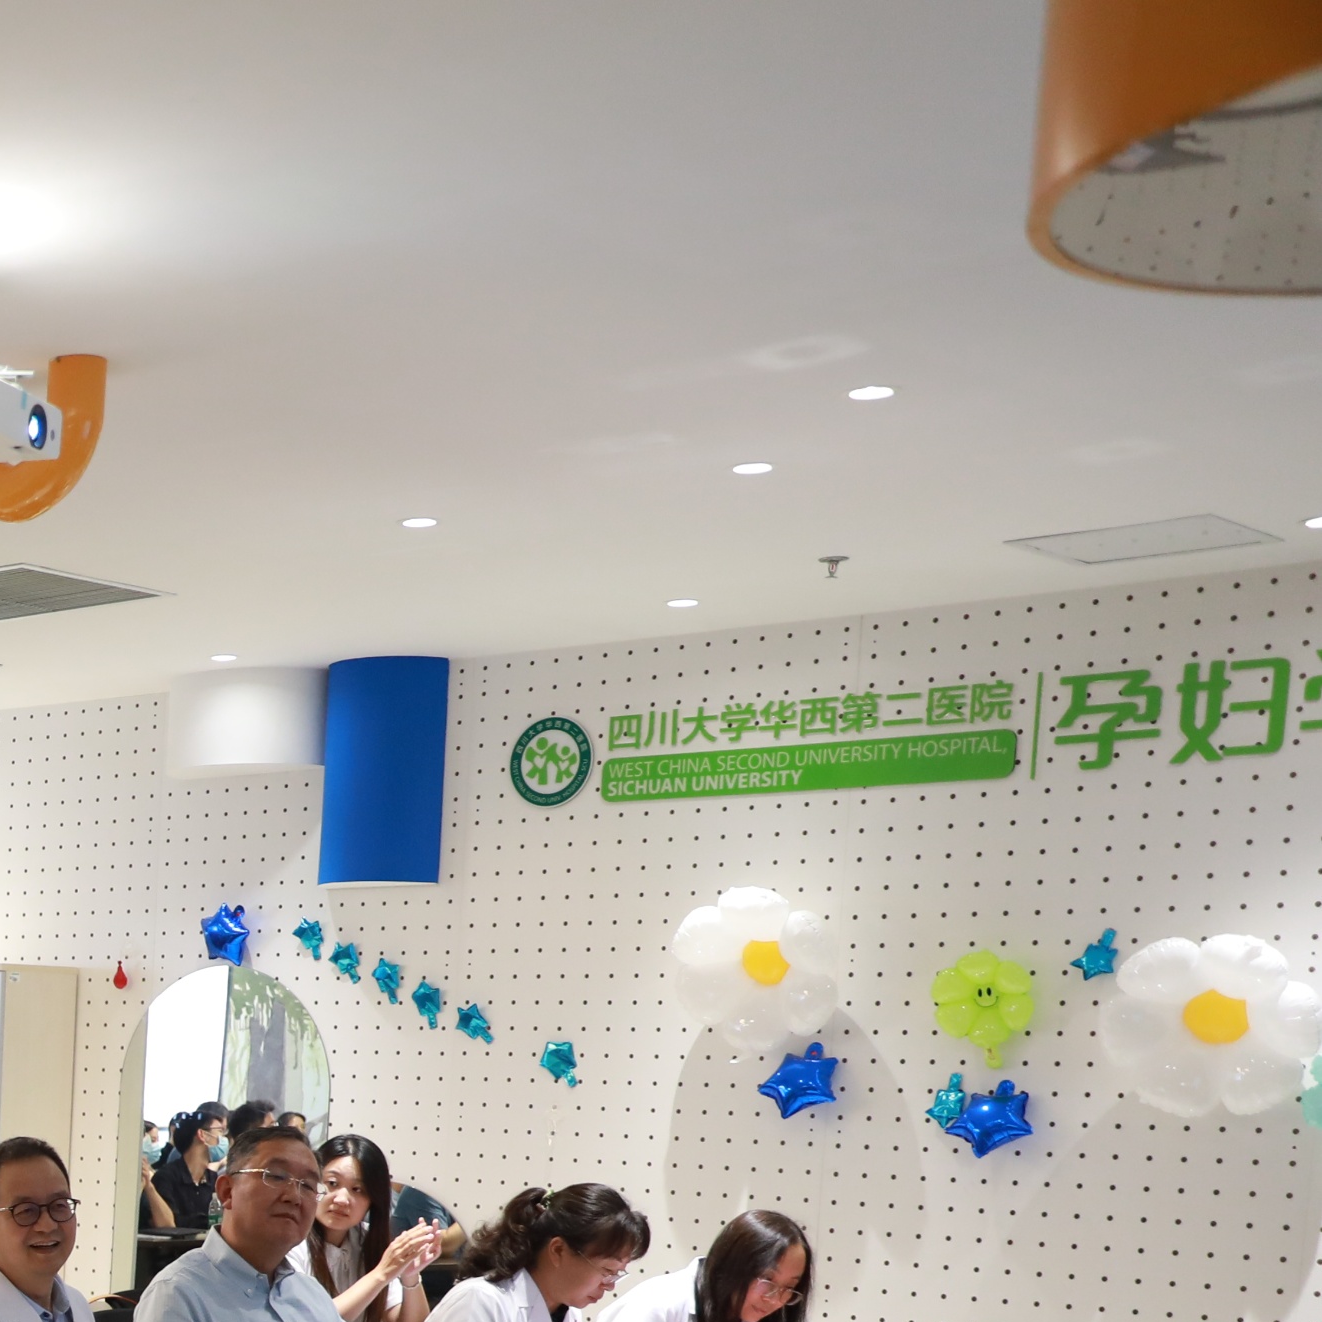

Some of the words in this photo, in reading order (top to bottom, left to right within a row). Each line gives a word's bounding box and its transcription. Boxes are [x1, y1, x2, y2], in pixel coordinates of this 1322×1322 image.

[607, 680, 1014, 751] 四川大学华西第二医院
[1054, 649, 1322, 770] 孕妇
[608, 777, 687, 796] SICHUAN
[692, 769, 803, 791] UNIVERSITY
[609, 761, 654, 778] WEST
[658, 757, 711, 775] CHINA
[717, 751, 790, 771] SECOND
[795, 742, 903, 766] UNIVERSITY
[908, 736, 1007, 758] HOSPITAL,
